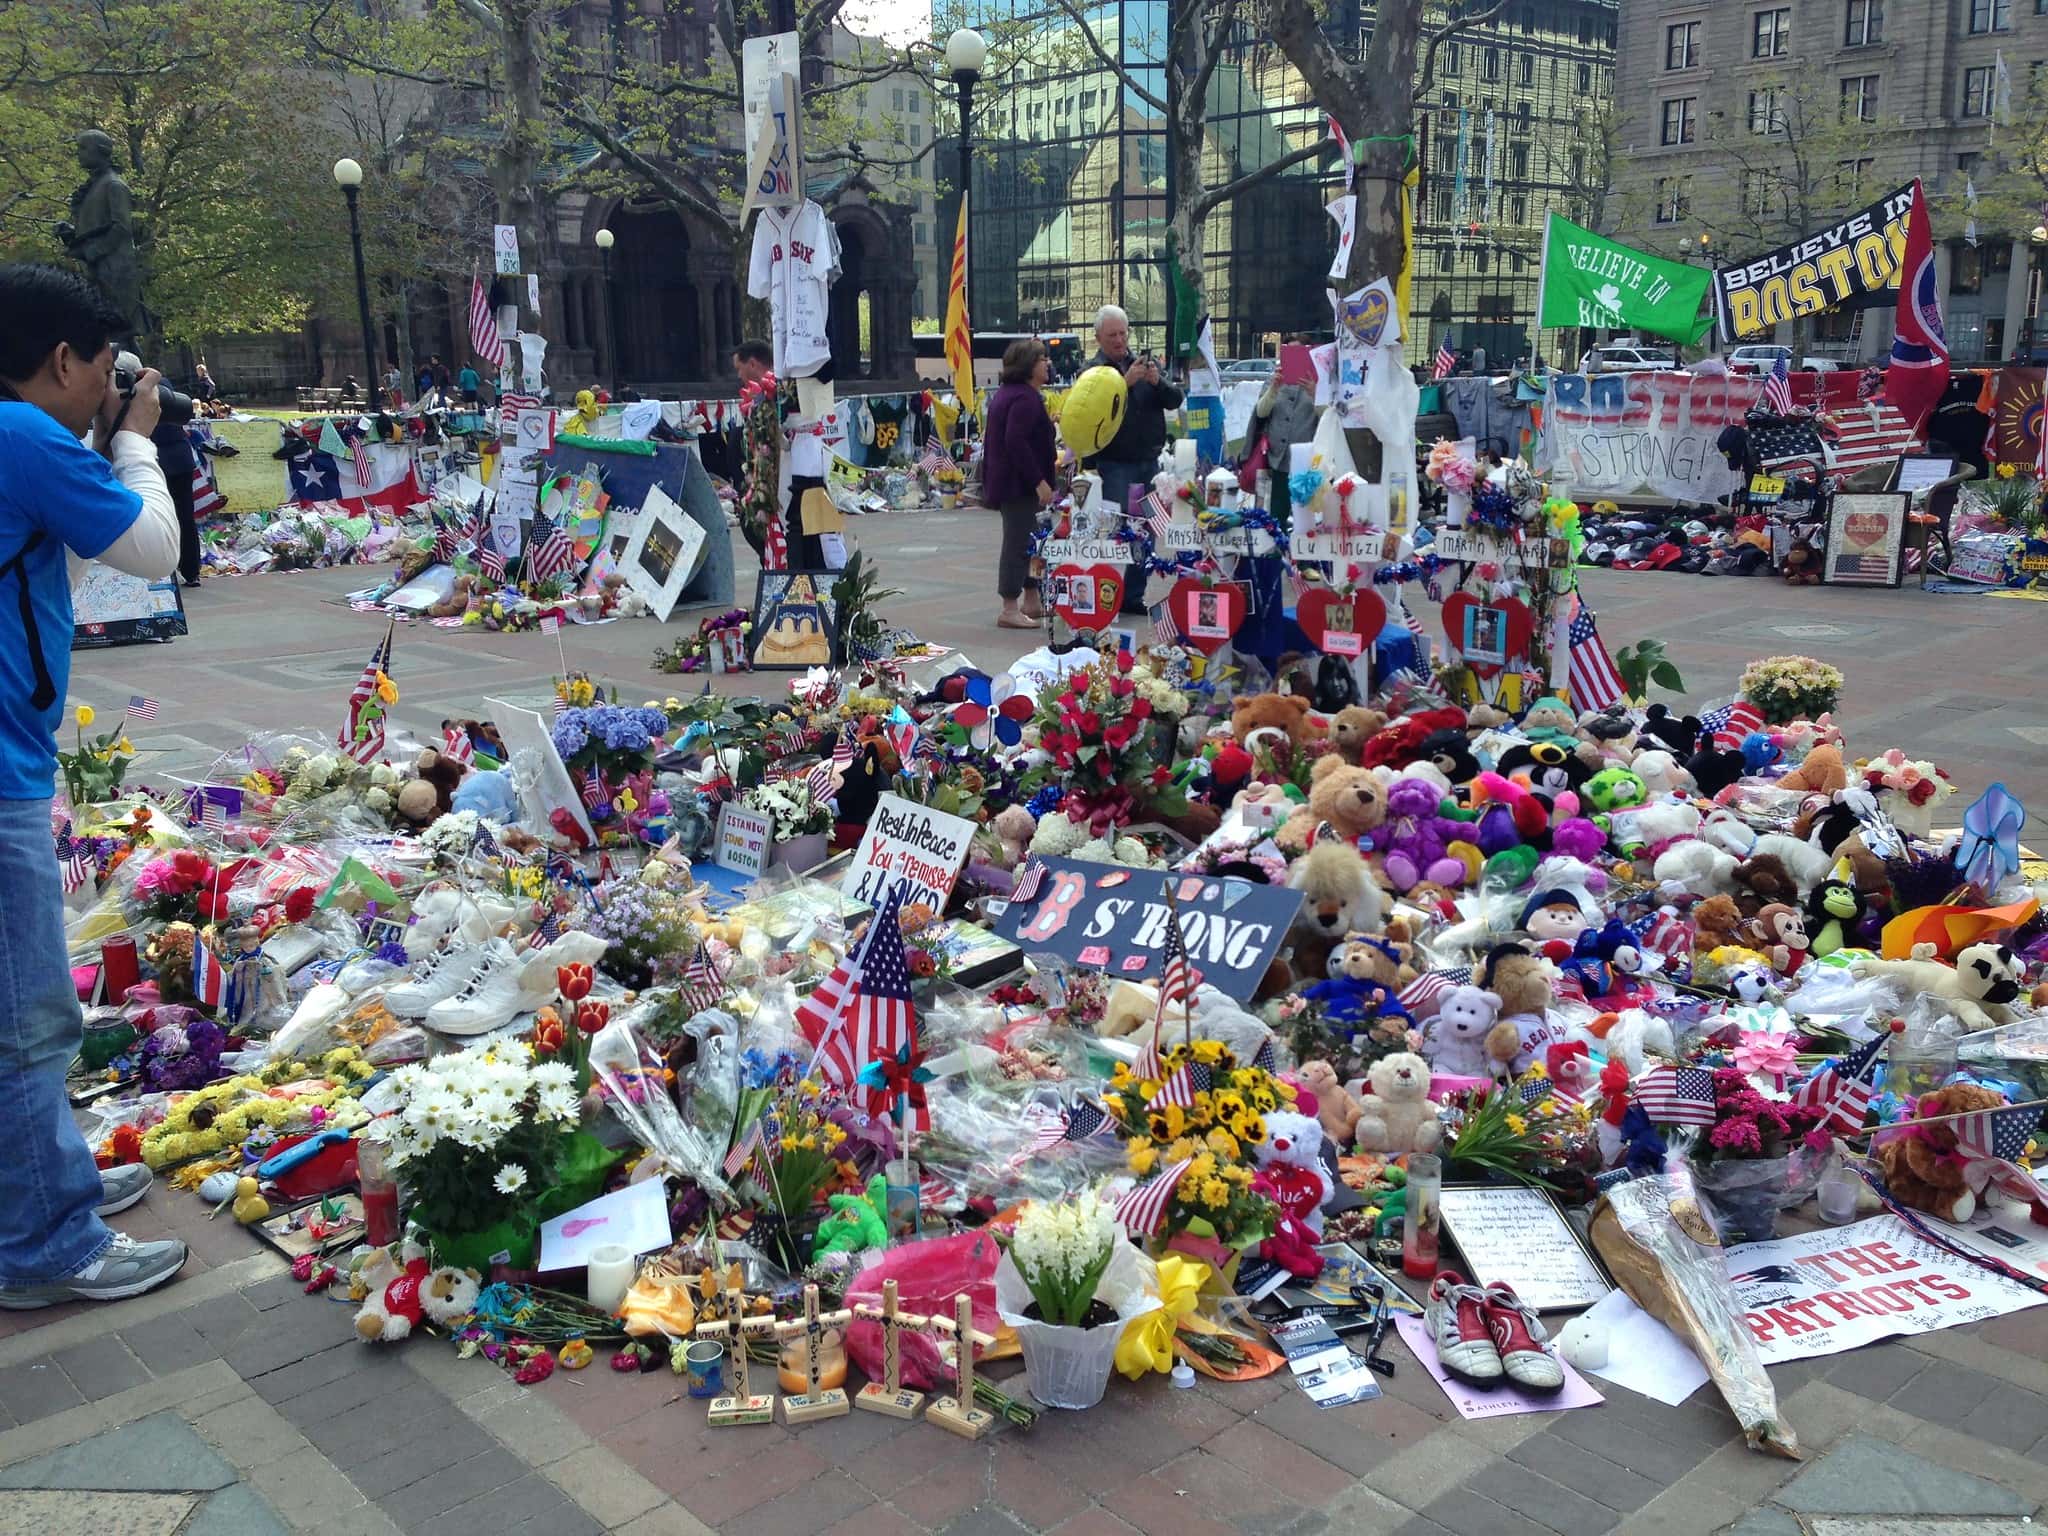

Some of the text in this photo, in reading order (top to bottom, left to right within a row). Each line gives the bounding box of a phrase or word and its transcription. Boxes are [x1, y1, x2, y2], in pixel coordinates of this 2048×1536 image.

[1724, 184, 1916, 290] BELIEVE IN
[1567, 243, 1673, 307] BELIEVE IN
[1577, 295, 1632, 329] BOS
[1554, 371, 1764, 430] BOSTON
[1581, 432, 1708, 484] STRONG!
[1043, 545, 1129, 560] SEAN COLLIER
[726, 815, 766, 836] ISTANBUL
[876, 806, 958, 862] Rest In Peace.
[728, 849, 760, 870] BOSTON
[868, 836, 893, 871] You
[917, 861, 958, 896] missed
[854, 870, 872, 903] &
[1015, 869, 1086, 943] B
[1521, 1028, 1549, 1054] RED
[1793, 1240, 1922, 1284] THE
[1744, 1273, 1972, 1342] PATRIOTS
[1477, 1402, 1521, 1412] ATHLETA
